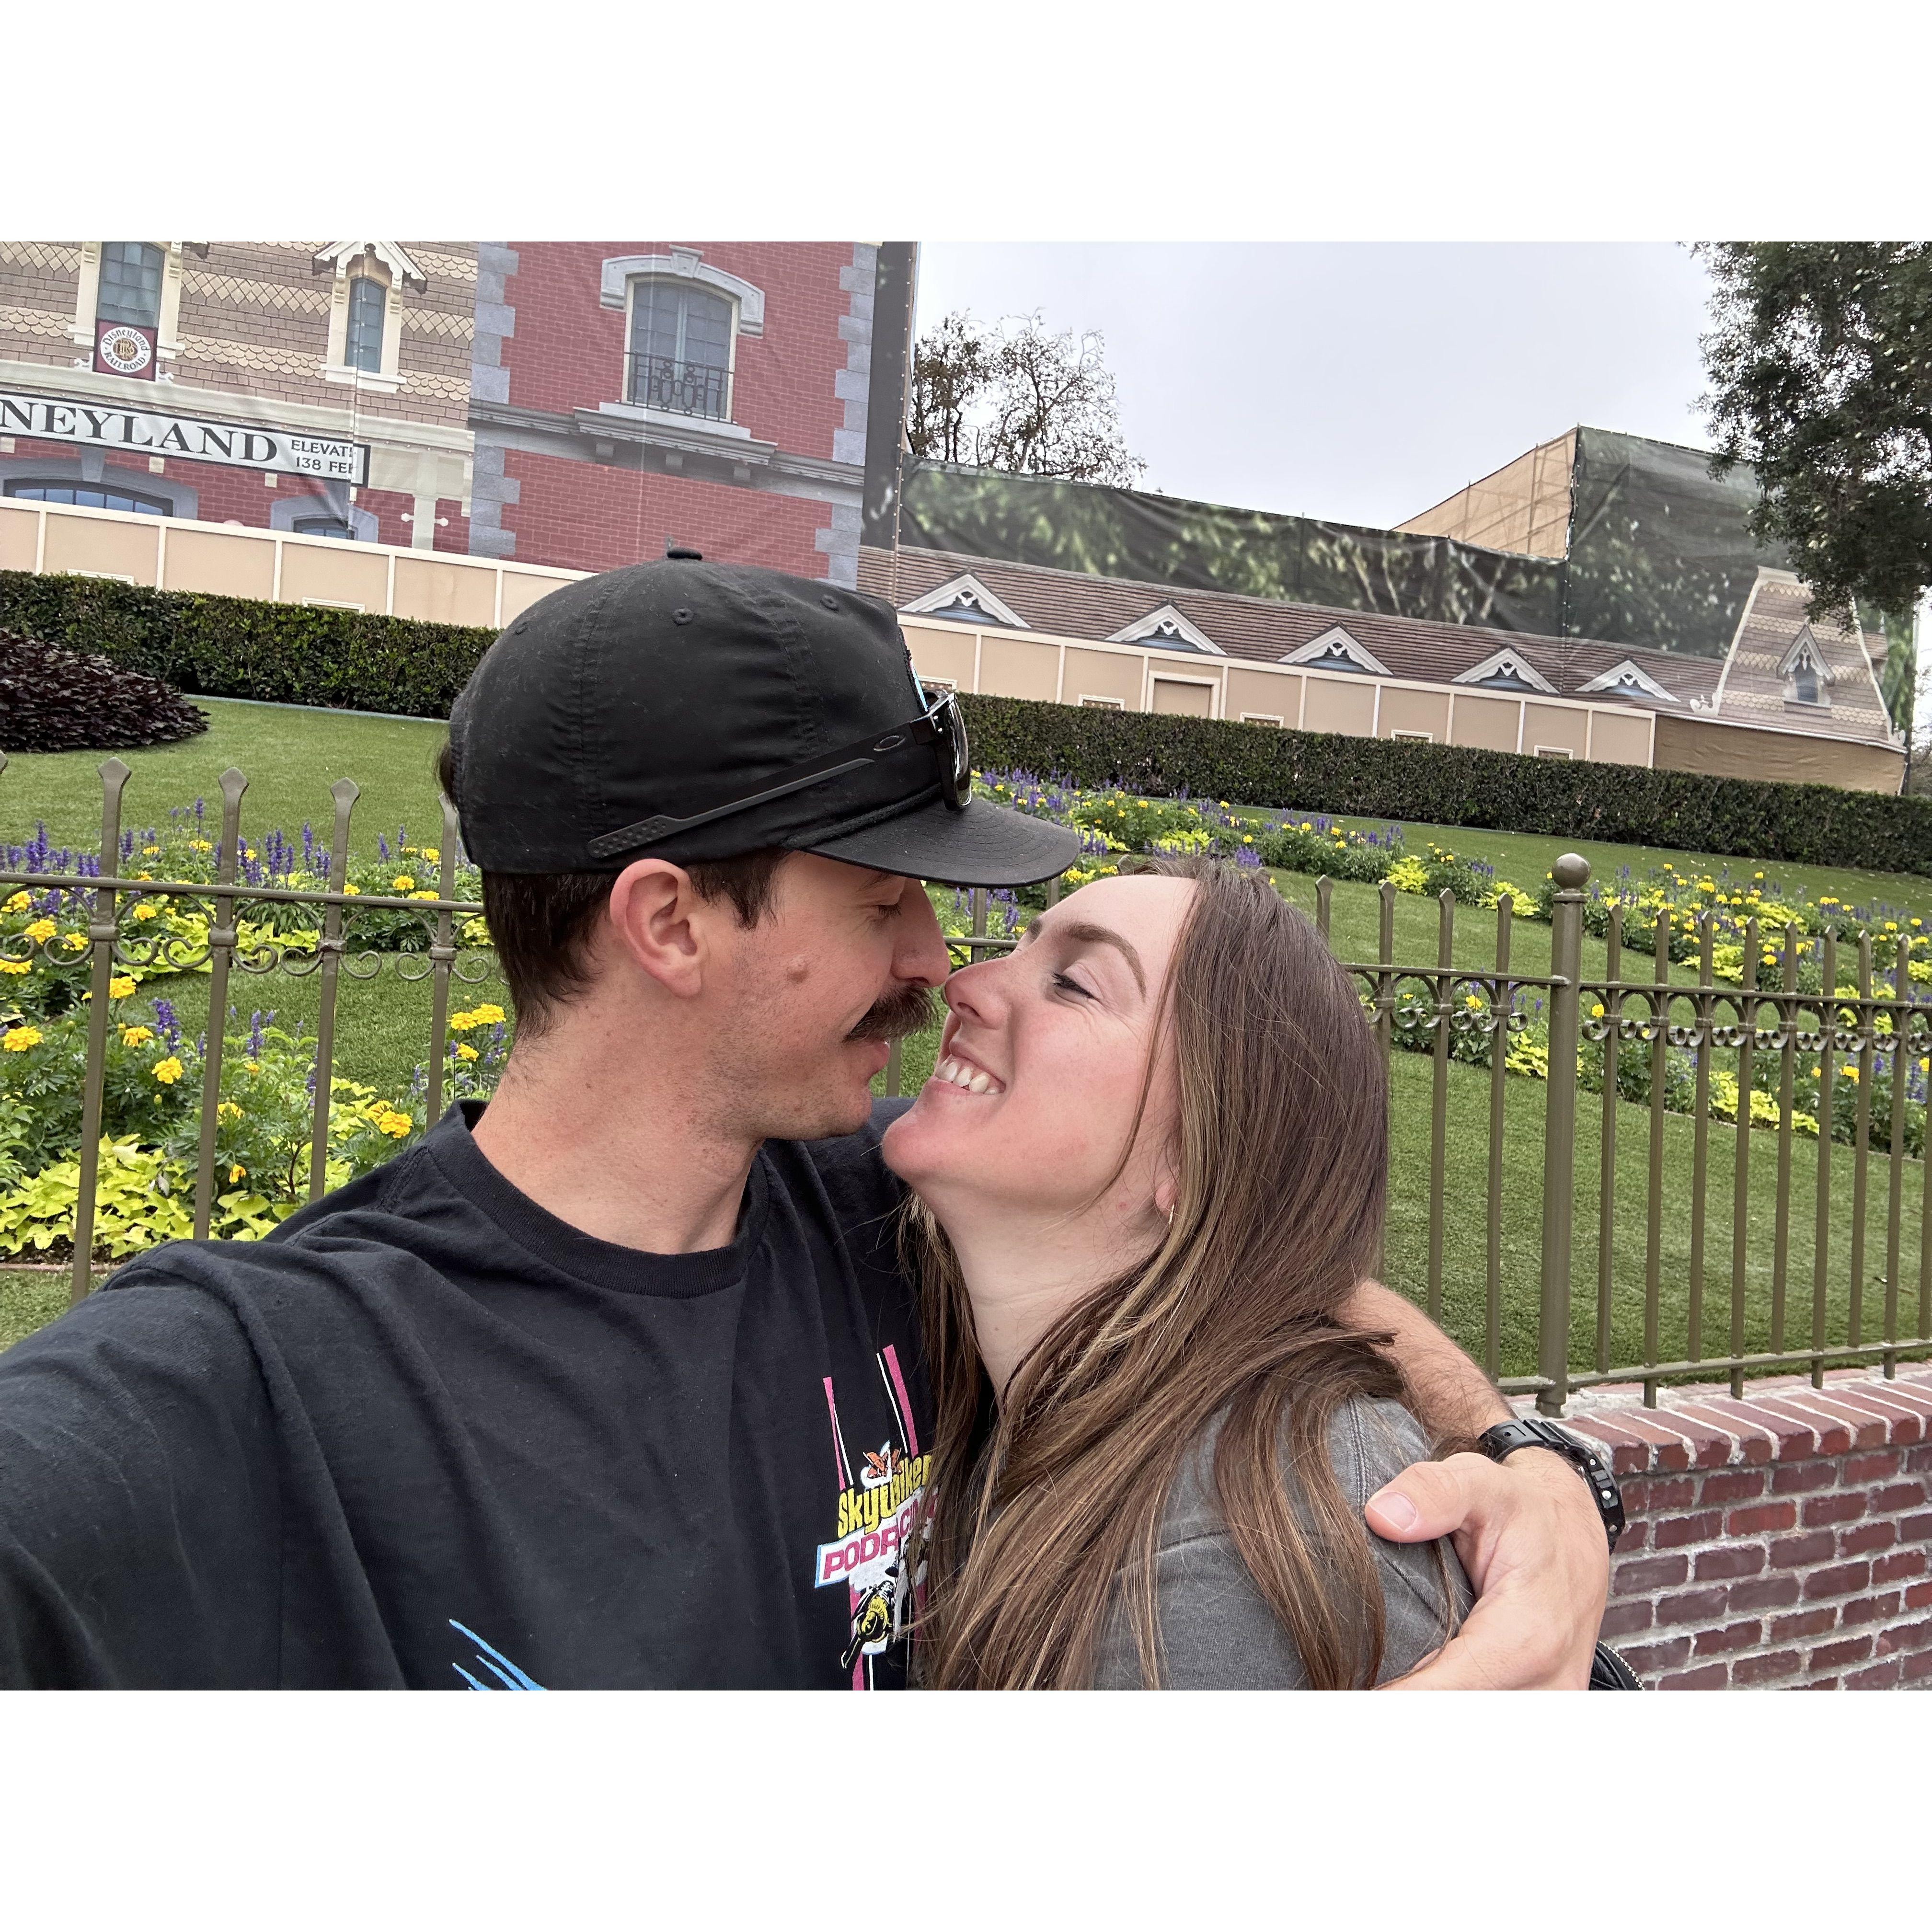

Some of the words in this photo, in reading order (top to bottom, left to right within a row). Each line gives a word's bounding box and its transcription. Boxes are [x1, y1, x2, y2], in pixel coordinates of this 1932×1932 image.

[103, 329, 150, 351] Disneyland
[104, 352, 146, 370] RAILROAD
[296, 456, 321, 471] 138
